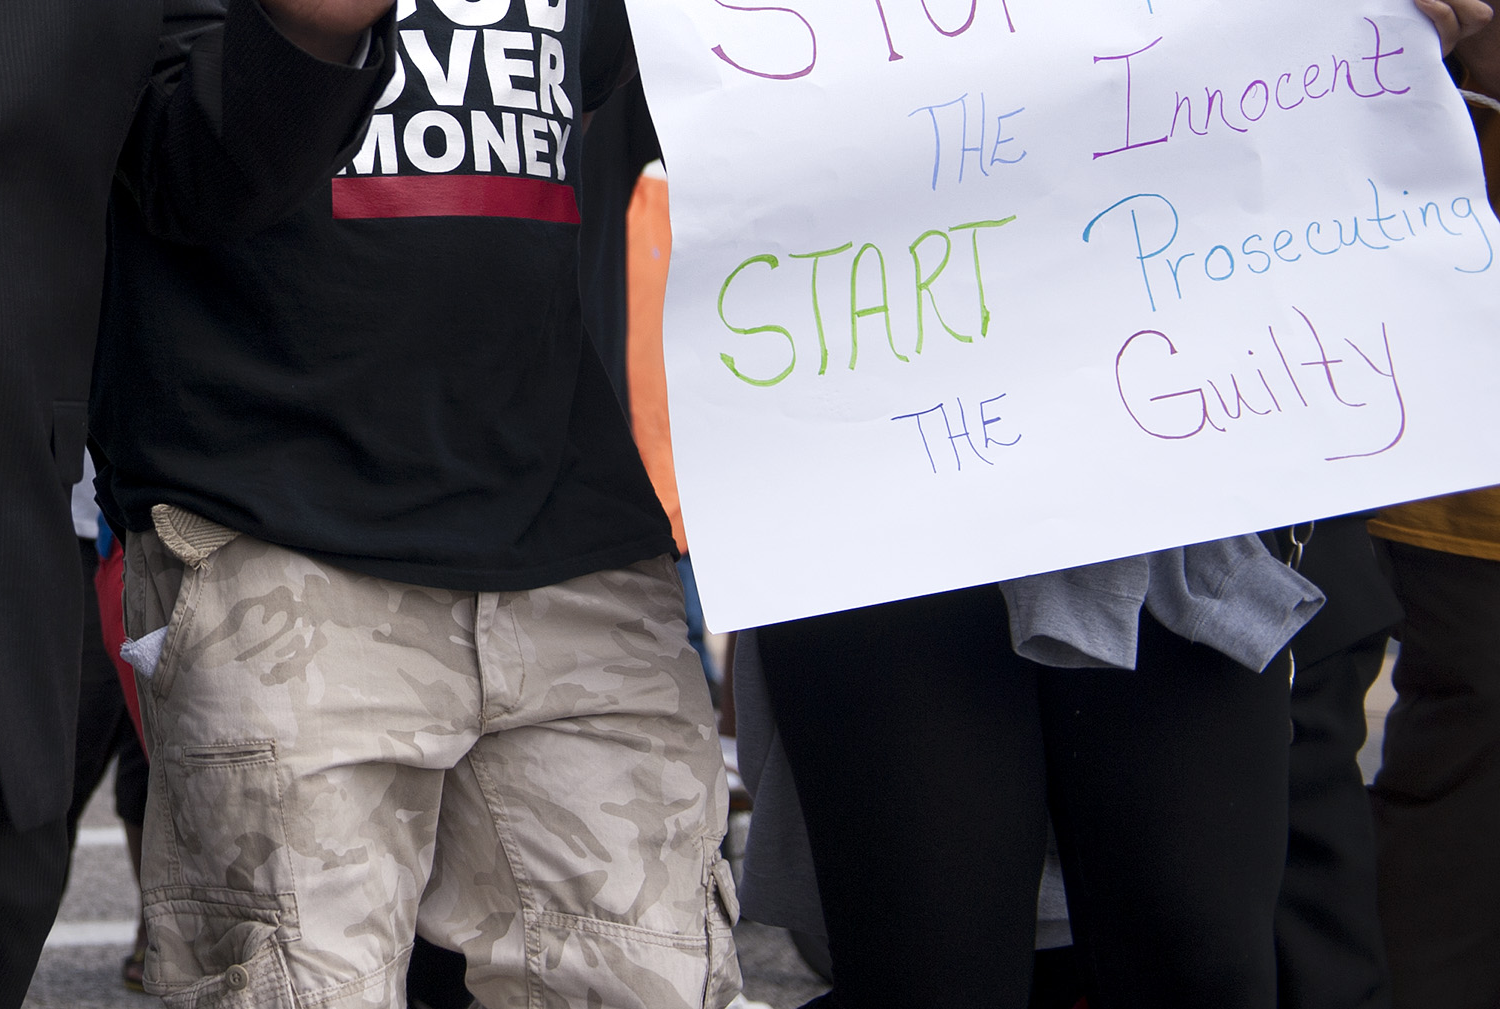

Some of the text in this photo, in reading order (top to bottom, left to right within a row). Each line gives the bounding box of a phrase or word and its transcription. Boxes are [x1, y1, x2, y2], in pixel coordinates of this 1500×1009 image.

[336, 110, 572, 181] MONEY
[908, 17, 1411, 190] THE Innocent
[717, 178, 1493, 386] START Prosecuting
[892, 306, 1406, 473] THE Guilty
